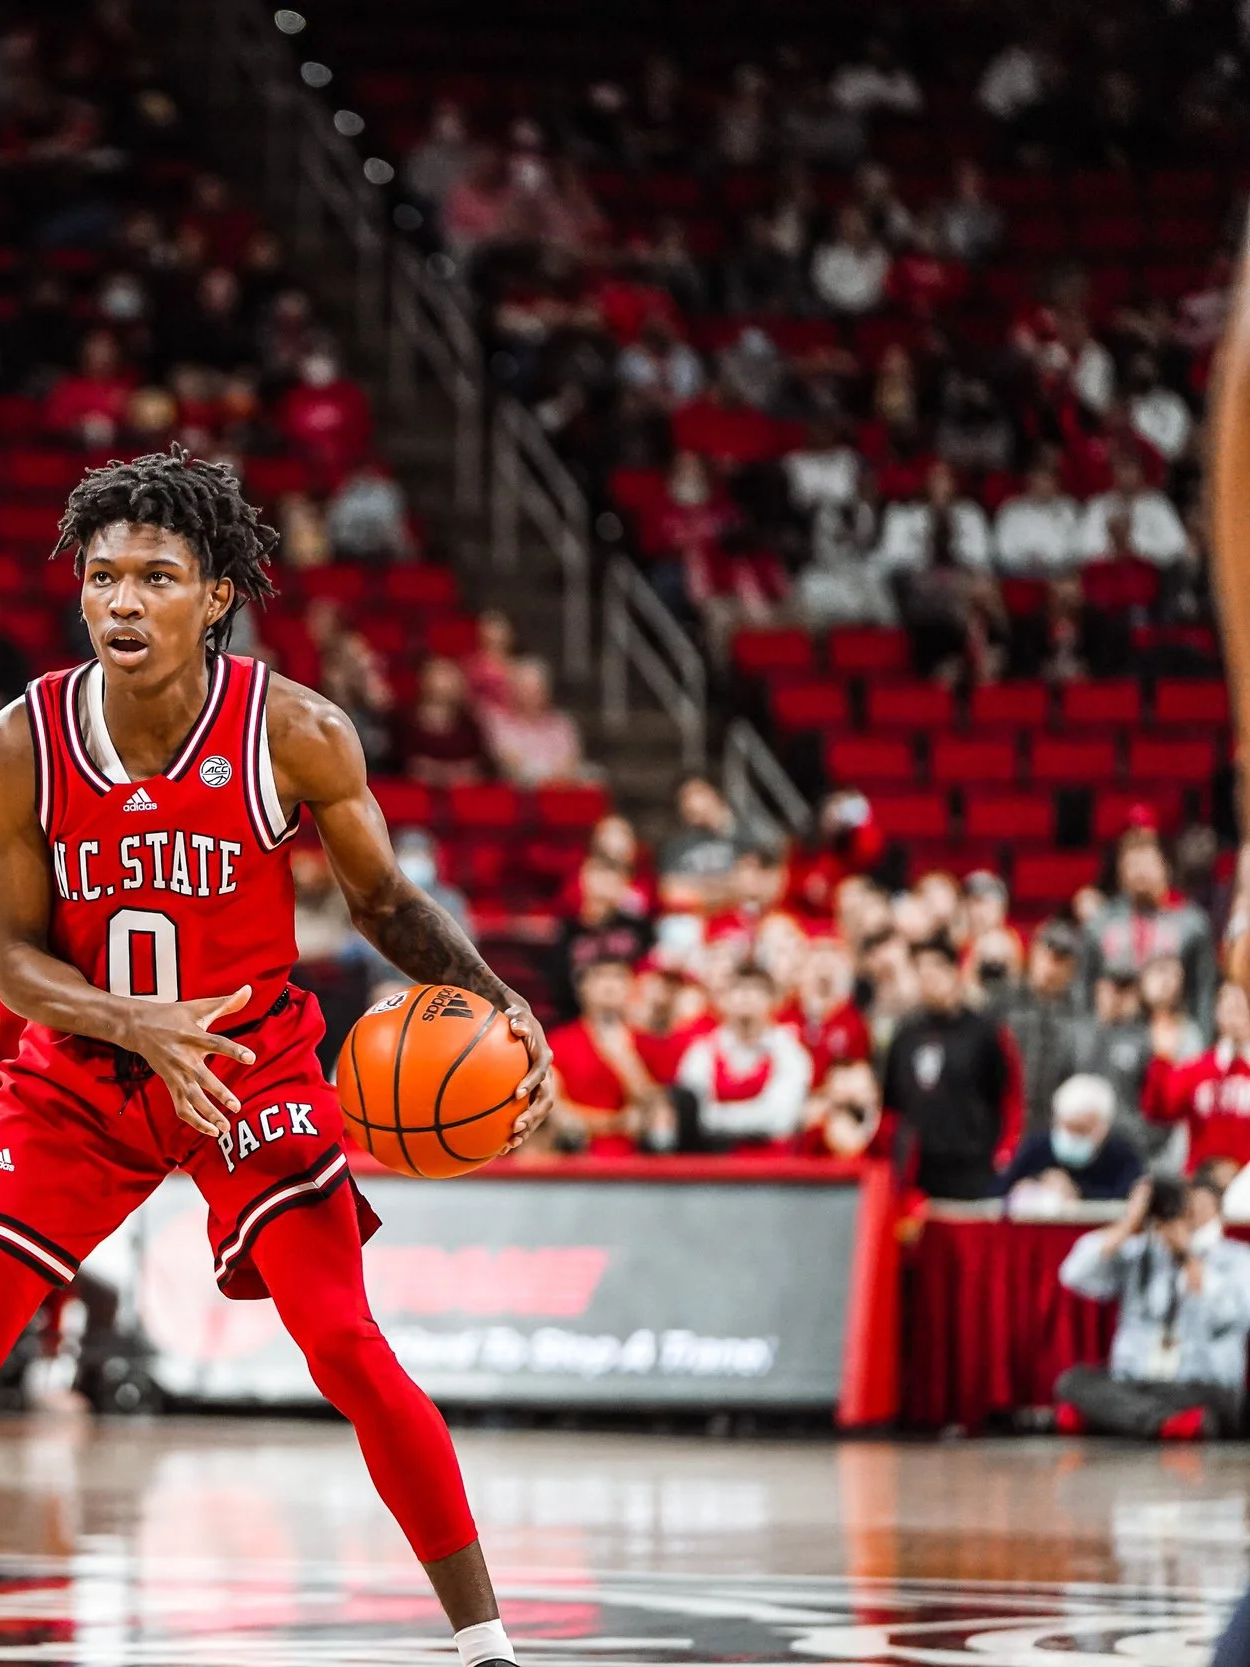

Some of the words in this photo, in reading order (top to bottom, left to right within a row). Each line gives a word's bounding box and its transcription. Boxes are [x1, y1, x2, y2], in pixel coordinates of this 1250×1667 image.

[204, 765, 229, 775] ACC
[122, 801, 158, 812] adidas
[53, 840, 115, 901] N.C.
[120, 830, 242, 897] STATE
[108, 906, 179, 1003] 0
[422, 987, 454, 1022] adidas
[217, 1102, 319, 1173] PACK
